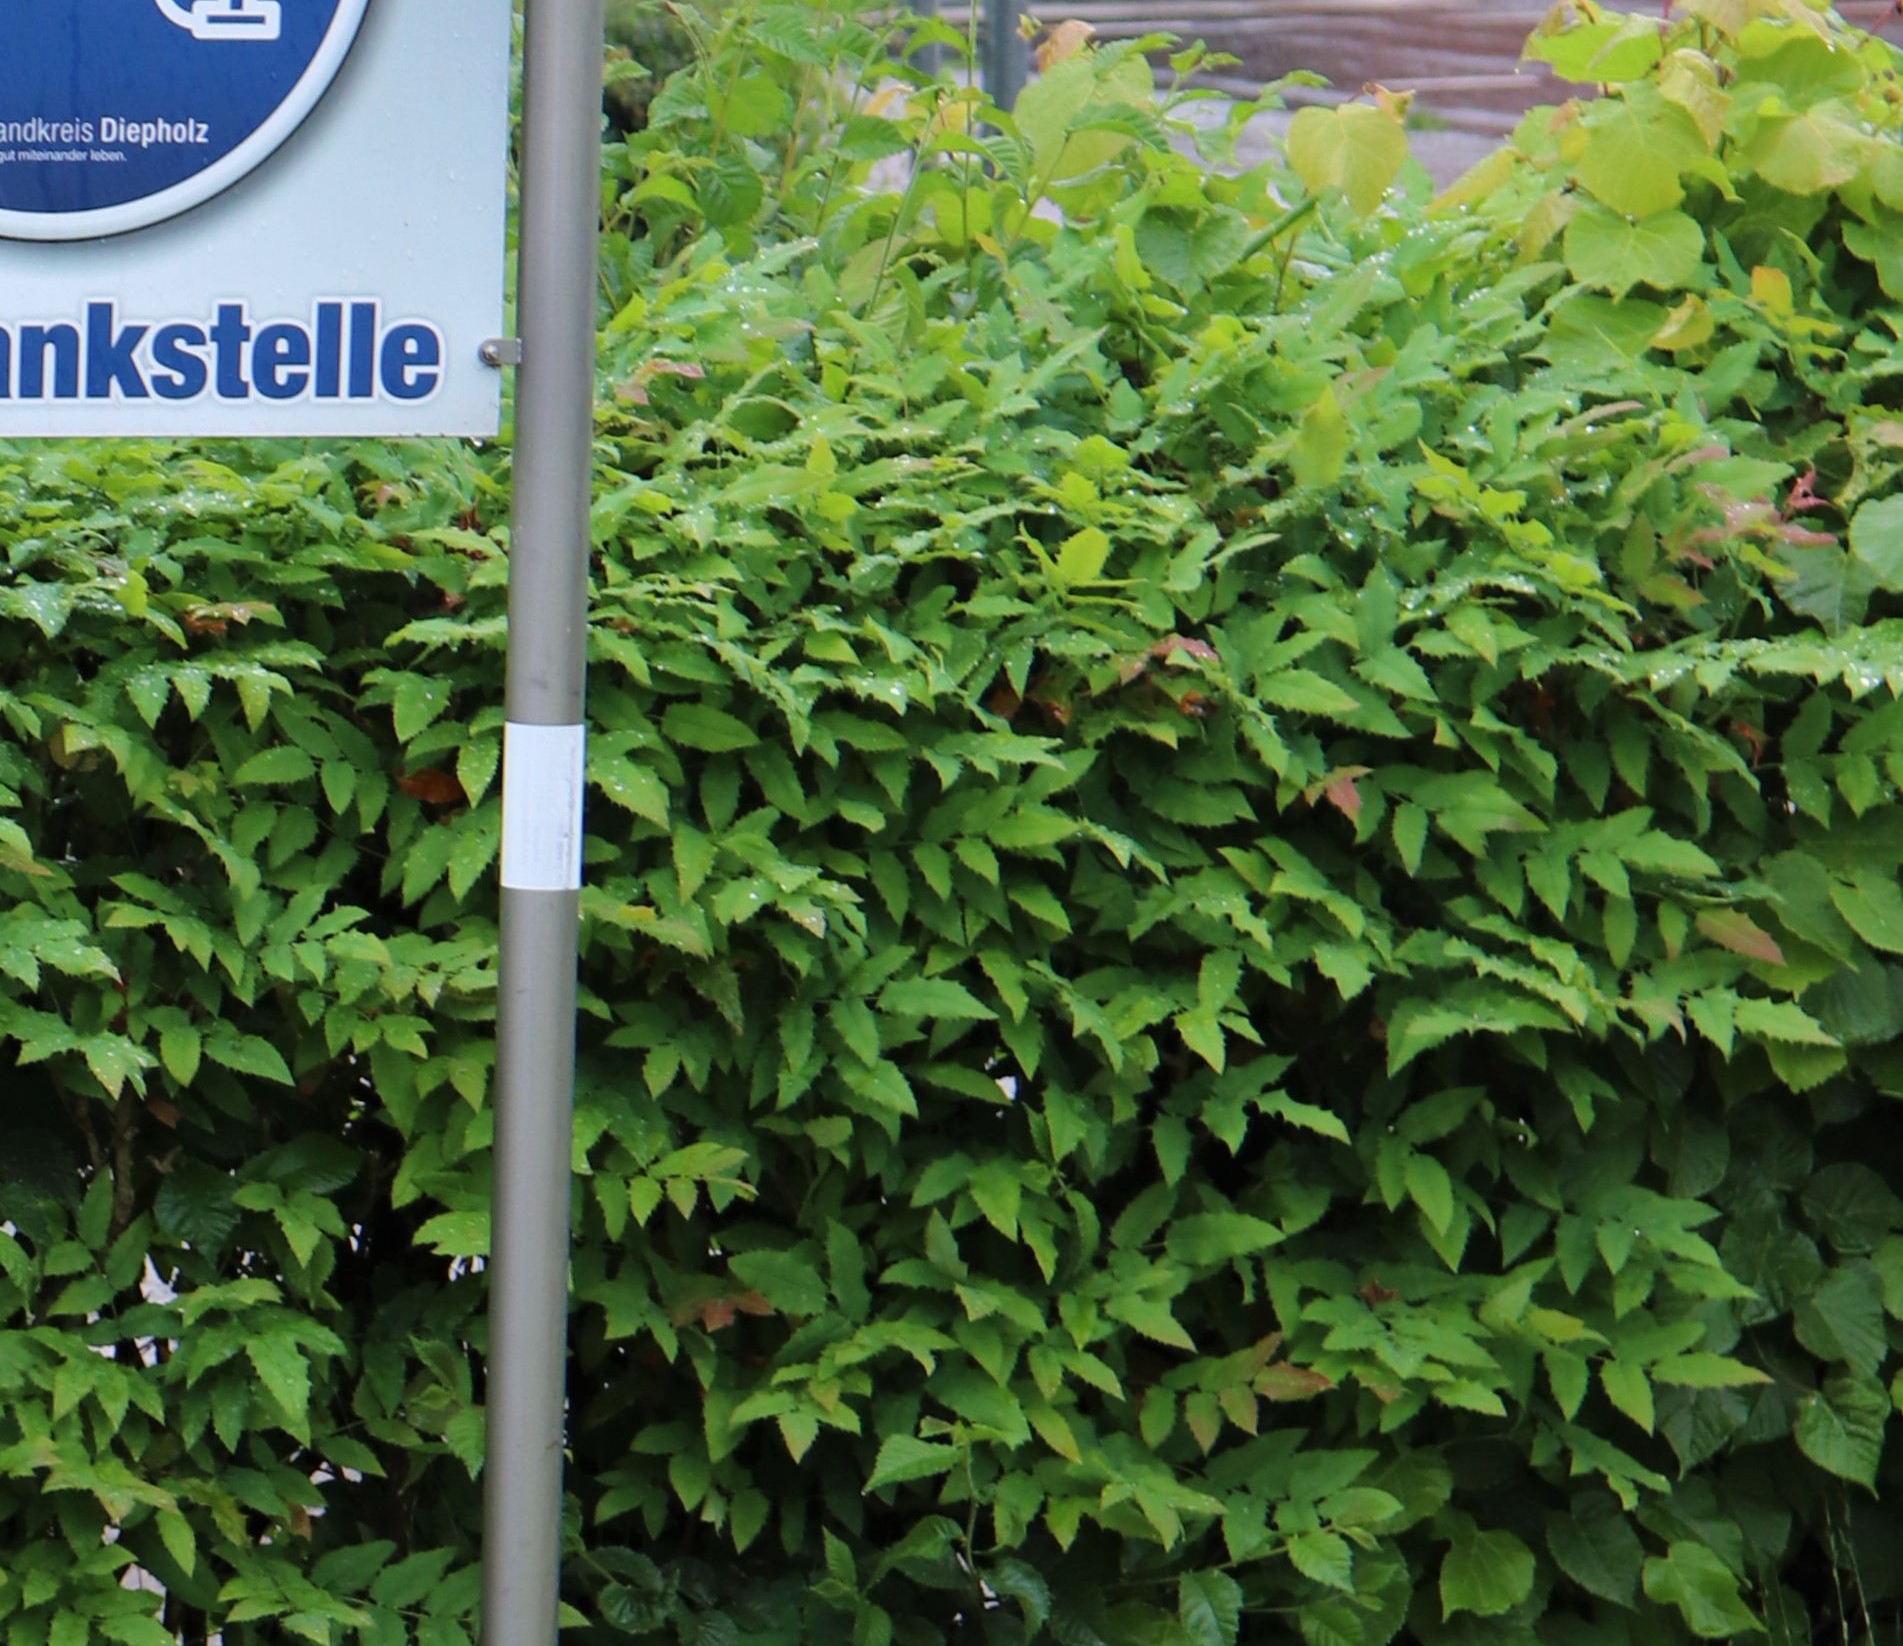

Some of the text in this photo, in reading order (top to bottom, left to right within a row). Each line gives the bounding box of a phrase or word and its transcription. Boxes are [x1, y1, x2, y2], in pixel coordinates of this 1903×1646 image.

[100, 116, 210, 148] Diepholz
[18, 149, 88, 163] miteinander
[90, 149, 128, 163] leben.
